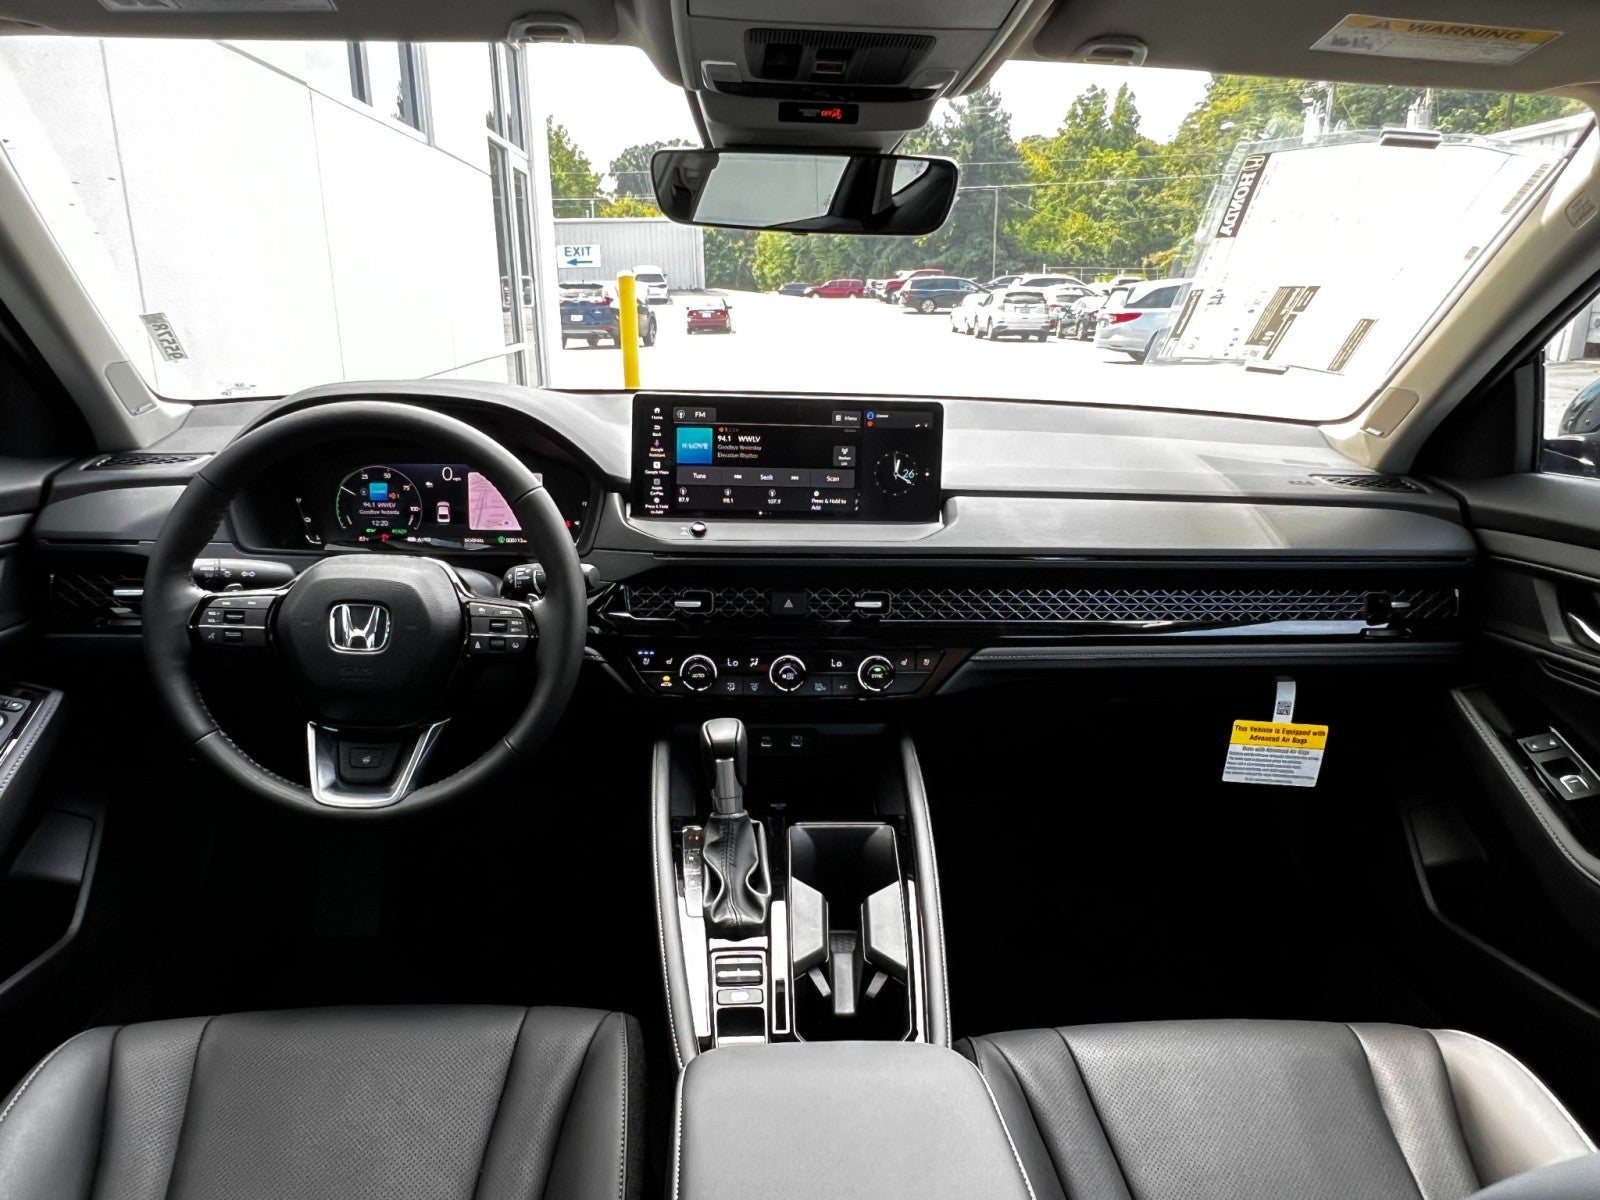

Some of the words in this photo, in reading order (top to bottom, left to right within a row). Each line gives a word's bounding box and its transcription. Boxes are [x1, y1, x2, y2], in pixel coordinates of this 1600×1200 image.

[1407, 22, 1528, 41] WARNING
[564, 246, 592, 257] EXIT
[442, 467, 453, 481] 0
[903, 469, 915, 479] 26
[727, 658, 739, 667] Lo
[831, 659, 843, 667] Lo
[1282, 728, 1310, 737] Equipped
[1249, 735, 1279, 743] Advanced
[1292, 737, 1308, 745] Bags
